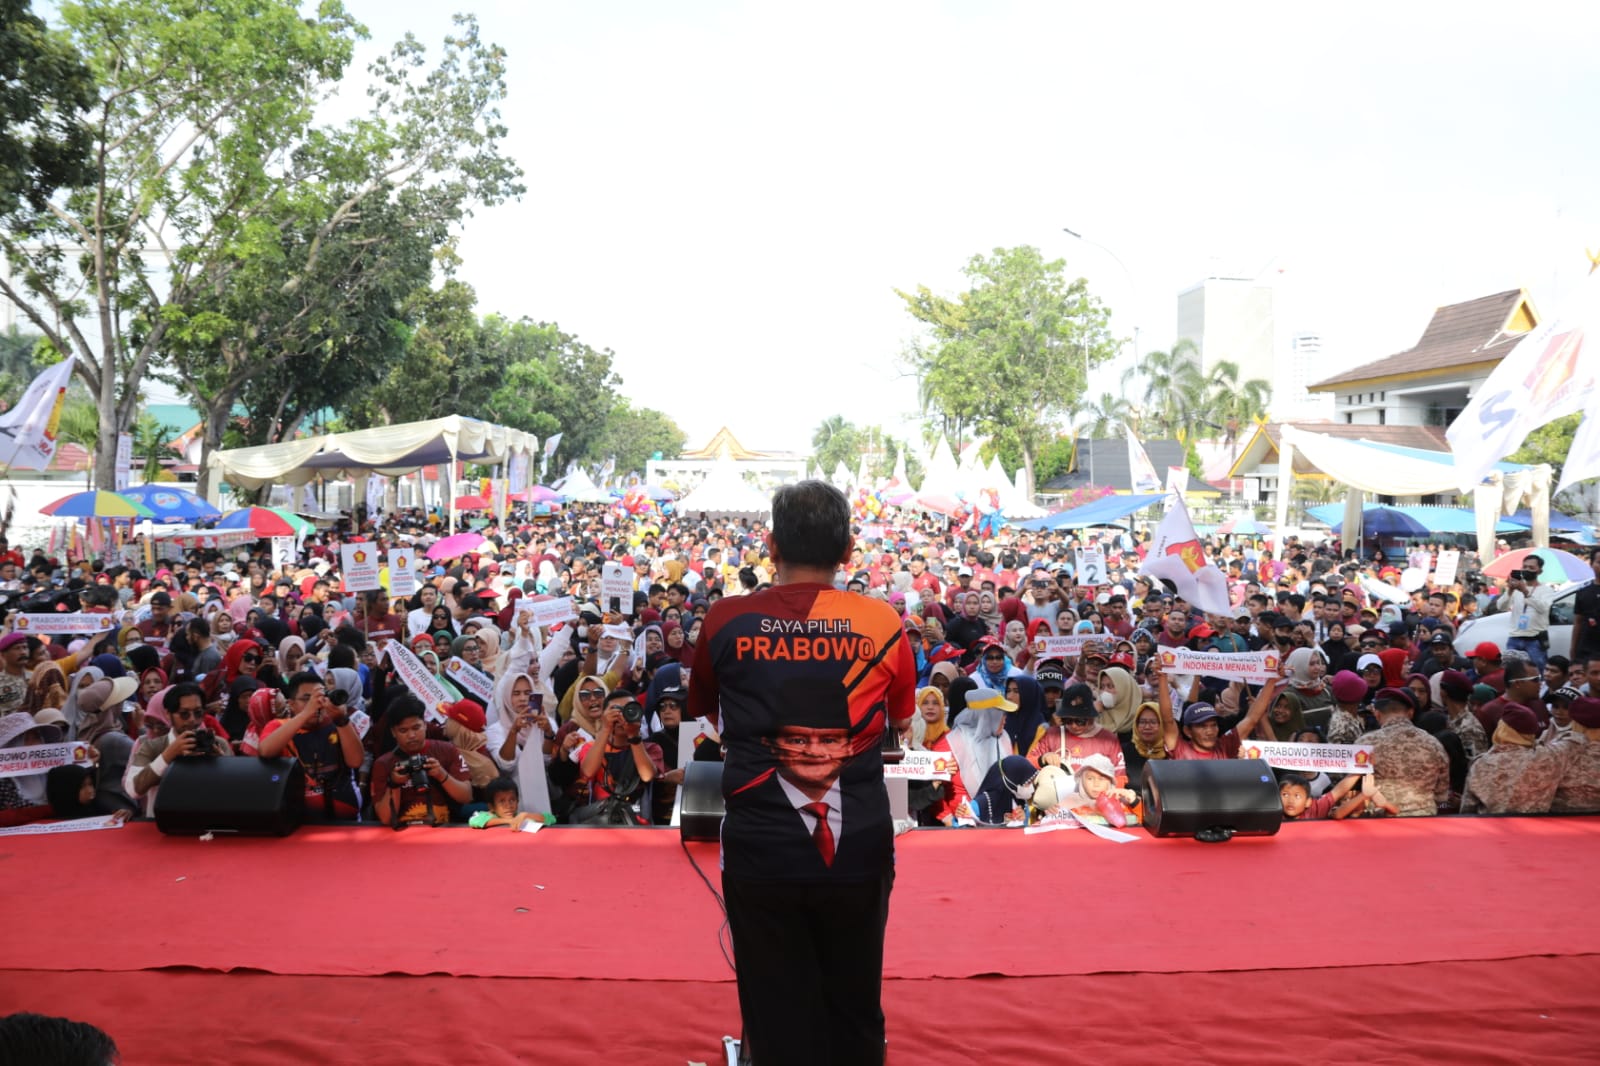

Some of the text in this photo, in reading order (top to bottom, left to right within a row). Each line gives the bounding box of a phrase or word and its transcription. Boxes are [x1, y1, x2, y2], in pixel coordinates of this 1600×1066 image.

[280, 549, 289, 563] 2
[1085, 564, 1099, 585] 2
[760, 618, 850, 634] SAYA PILIH
[736, 636, 876, 662] PRABOWO
[1183, 661, 1257, 672] INDONESIA MENANG
[415, 666, 446, 701] PRESIDEN
[29, 747, 72, 760] PRESIDEN
[1118, 752, 1126, 766] 2
[1264, 746, 1353, 759] PRABOWO PRESIDEN
[31, 758, 65, 769] MENANG
[1268, 757, 1347, 768] INDONESIA MENANG
[890, 766, 926, 776] MENANG
